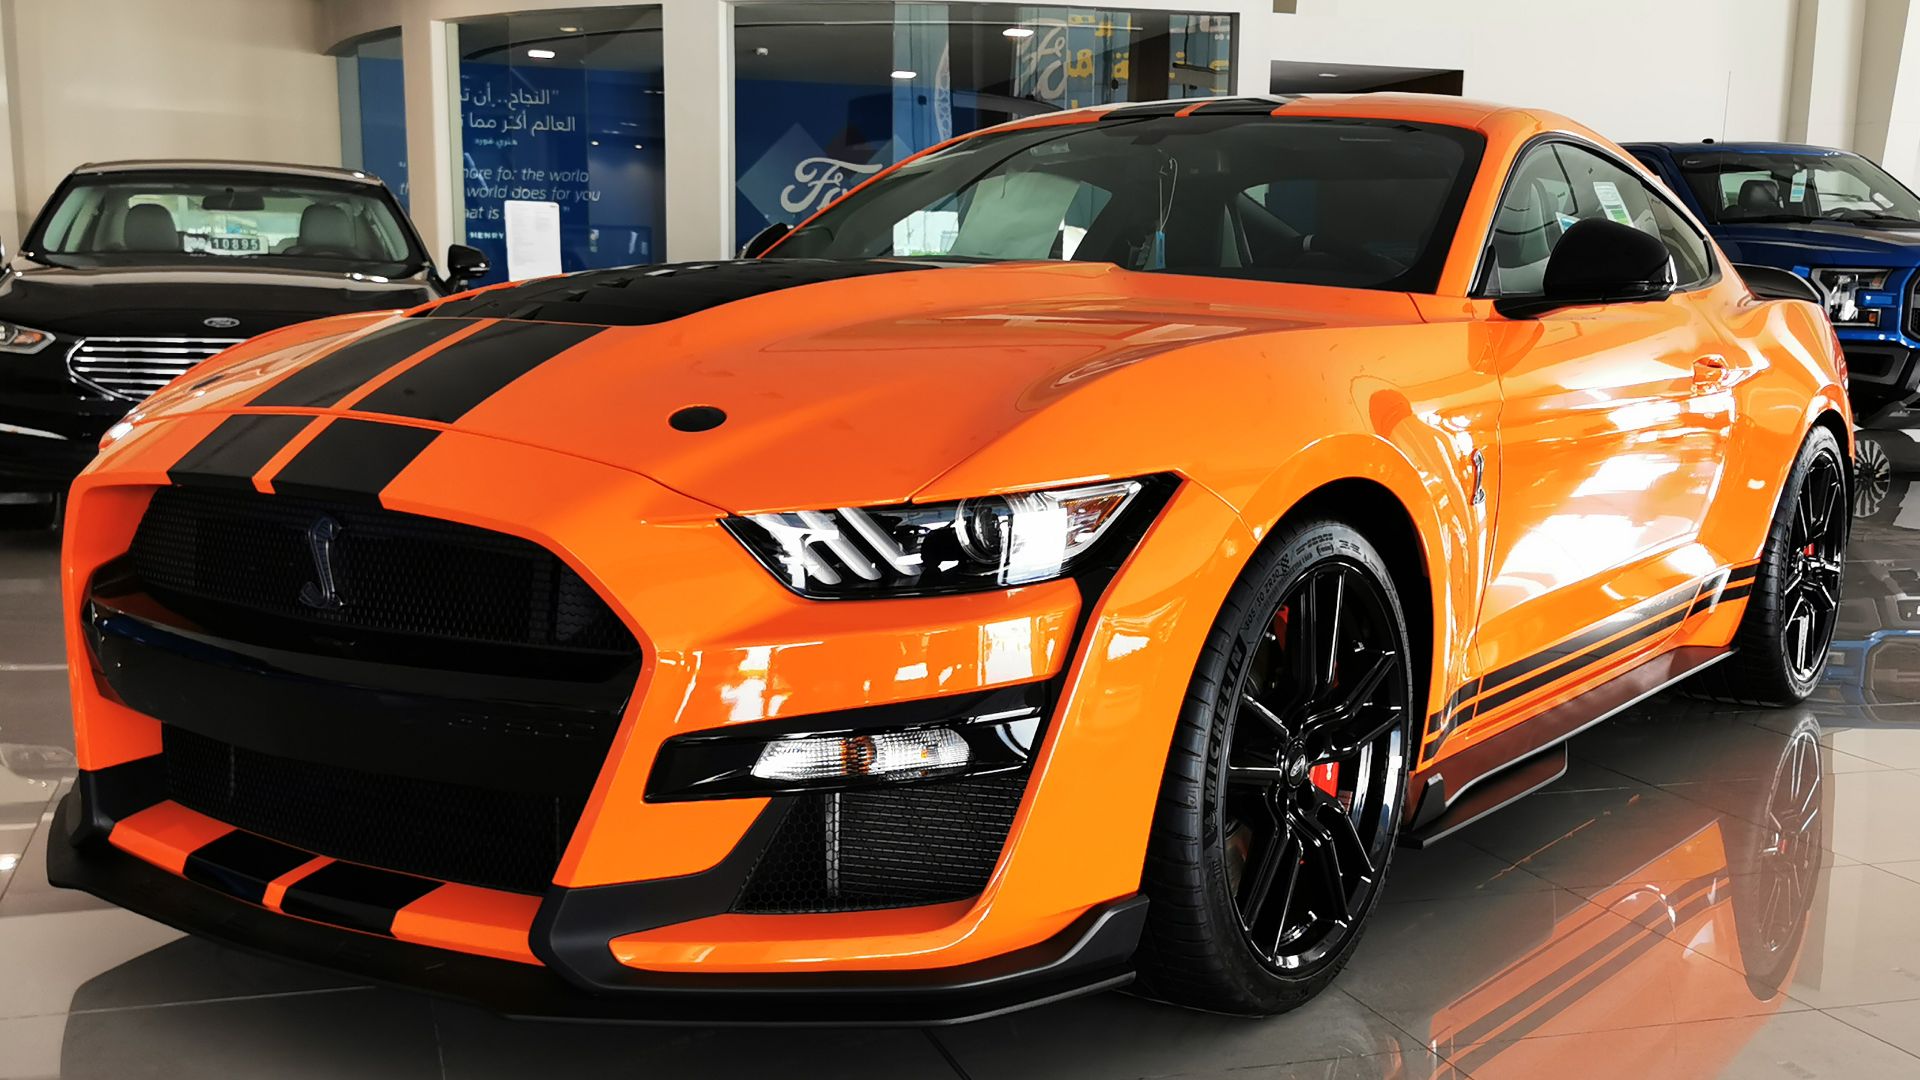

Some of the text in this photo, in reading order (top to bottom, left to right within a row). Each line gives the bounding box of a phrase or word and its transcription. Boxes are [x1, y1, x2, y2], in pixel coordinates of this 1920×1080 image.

[470, 112, 497, 128] مما
[531, 115, 576, 136] العالم
[521, 167, 545, 181] the
[467, 185, 601, 203] world does for you
[488, 205, 500, 220] is
[469, 231, 504, 240] HENRY
[1205, 643, 1244, 804] MICHELIN
